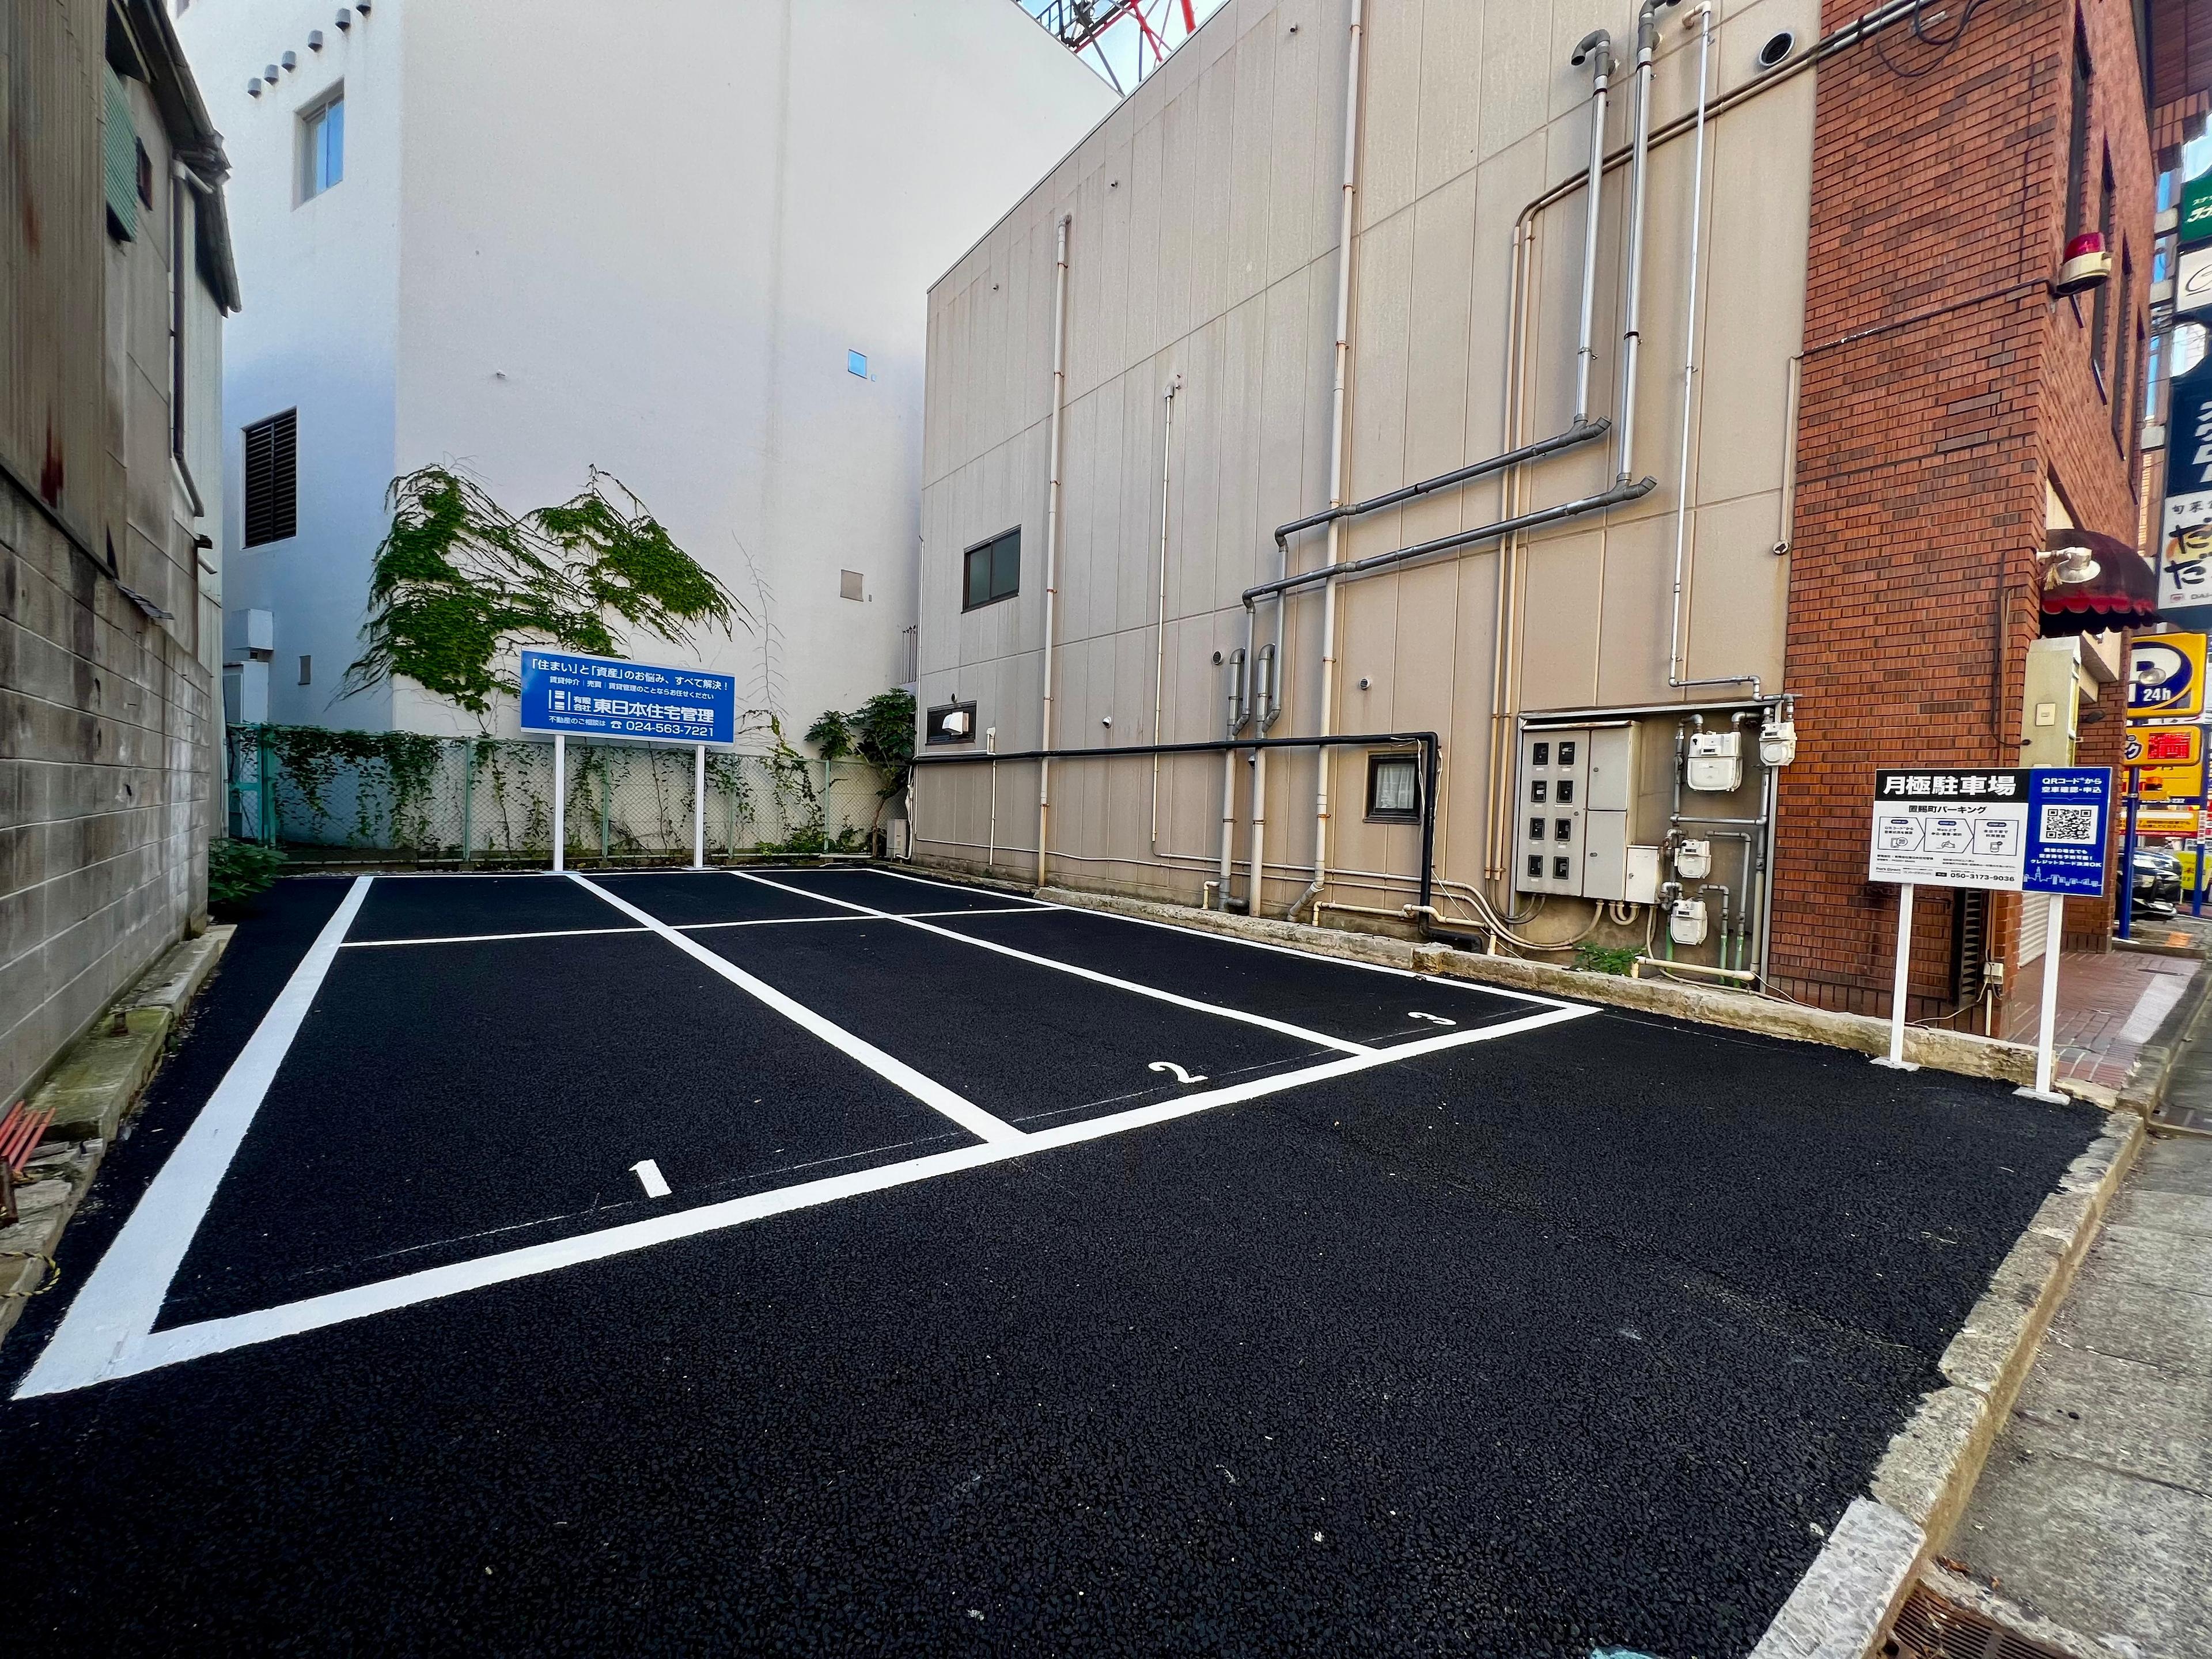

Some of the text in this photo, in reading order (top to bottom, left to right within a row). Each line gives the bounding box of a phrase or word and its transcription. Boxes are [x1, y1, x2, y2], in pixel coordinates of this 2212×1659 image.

[2143, 687, 2171, 702] 24h
[593, 698, 714, 724] 東日本住宅管理
[626, 721, 714, 737] 024-563-7221
[1883, 775, 2017, 796] 月極駐車場
[1407, 1012, 1457, 1025] 3
[1147, 1061, 1209, 1084] 2
[628, 1159, 673, 1199] 1
